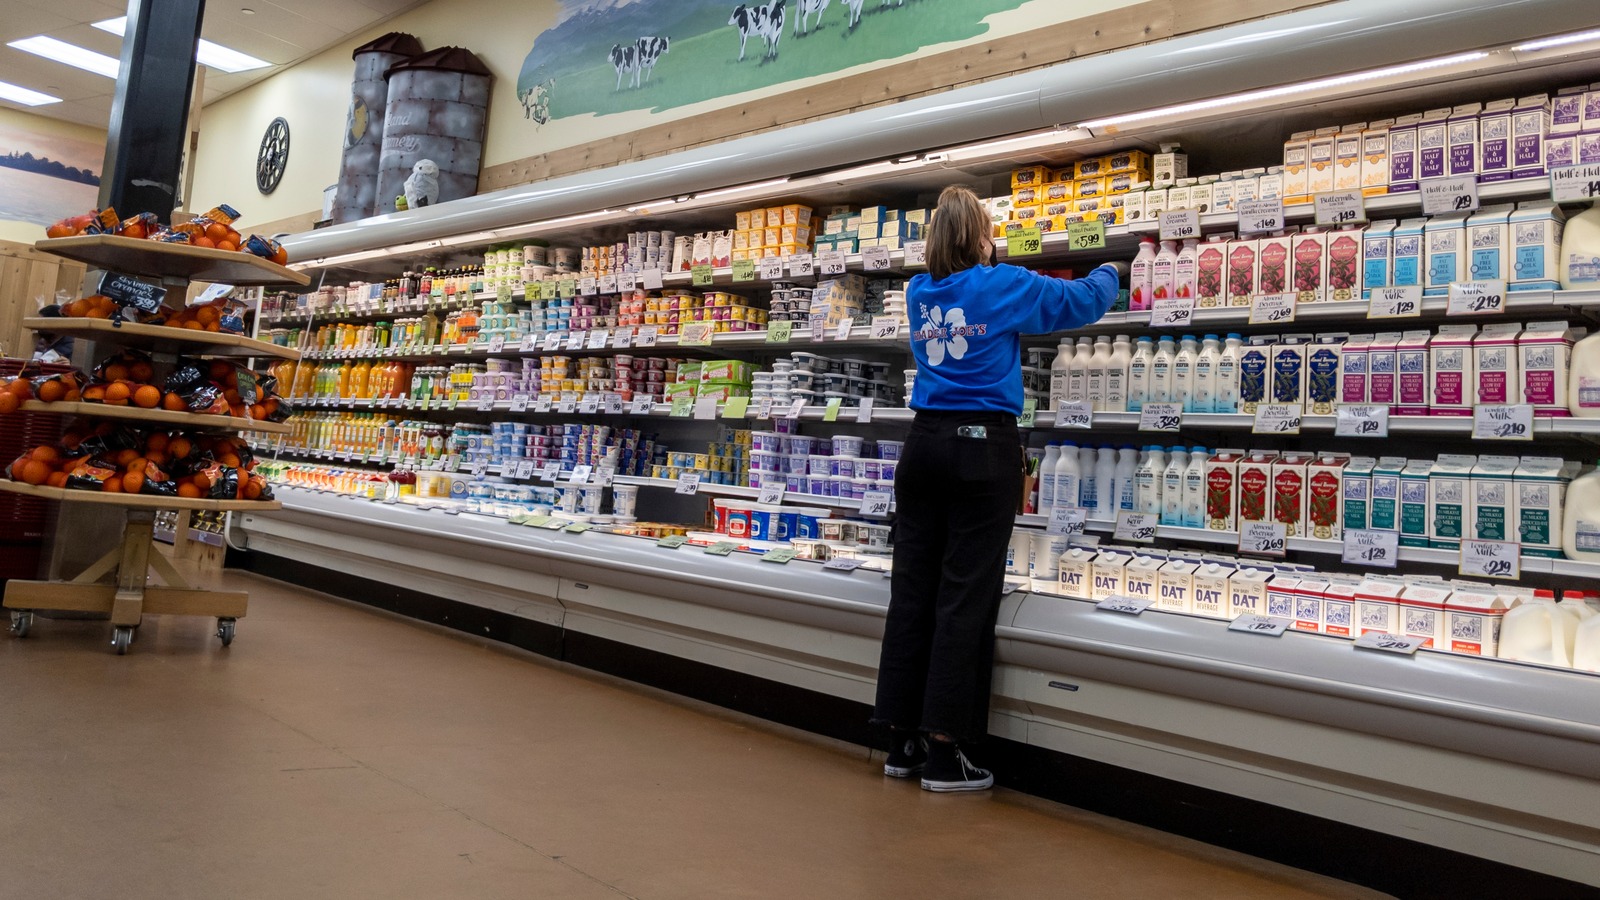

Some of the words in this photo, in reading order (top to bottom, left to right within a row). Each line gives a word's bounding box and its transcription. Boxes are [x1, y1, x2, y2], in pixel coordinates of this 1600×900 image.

[1554, 168, 1575, 180] Half
[1449, 184, 1464, 192] Half
[1320, 194, 1355, 203] Buttermilk
[952, 324, 987, 337] JOE'S
[1062, 572, 1082, 584] OAT
[1096, 576, 1118, 589] OAT
[1129, 581, 1151, 594] OAT
[1162, 585, 1186, 599] OAT
[1196, 589, 1221, 603] OAT
[1233, 594, 1259, 608] OAT
[1197, 603, 1218, 611] BEVERAGE
